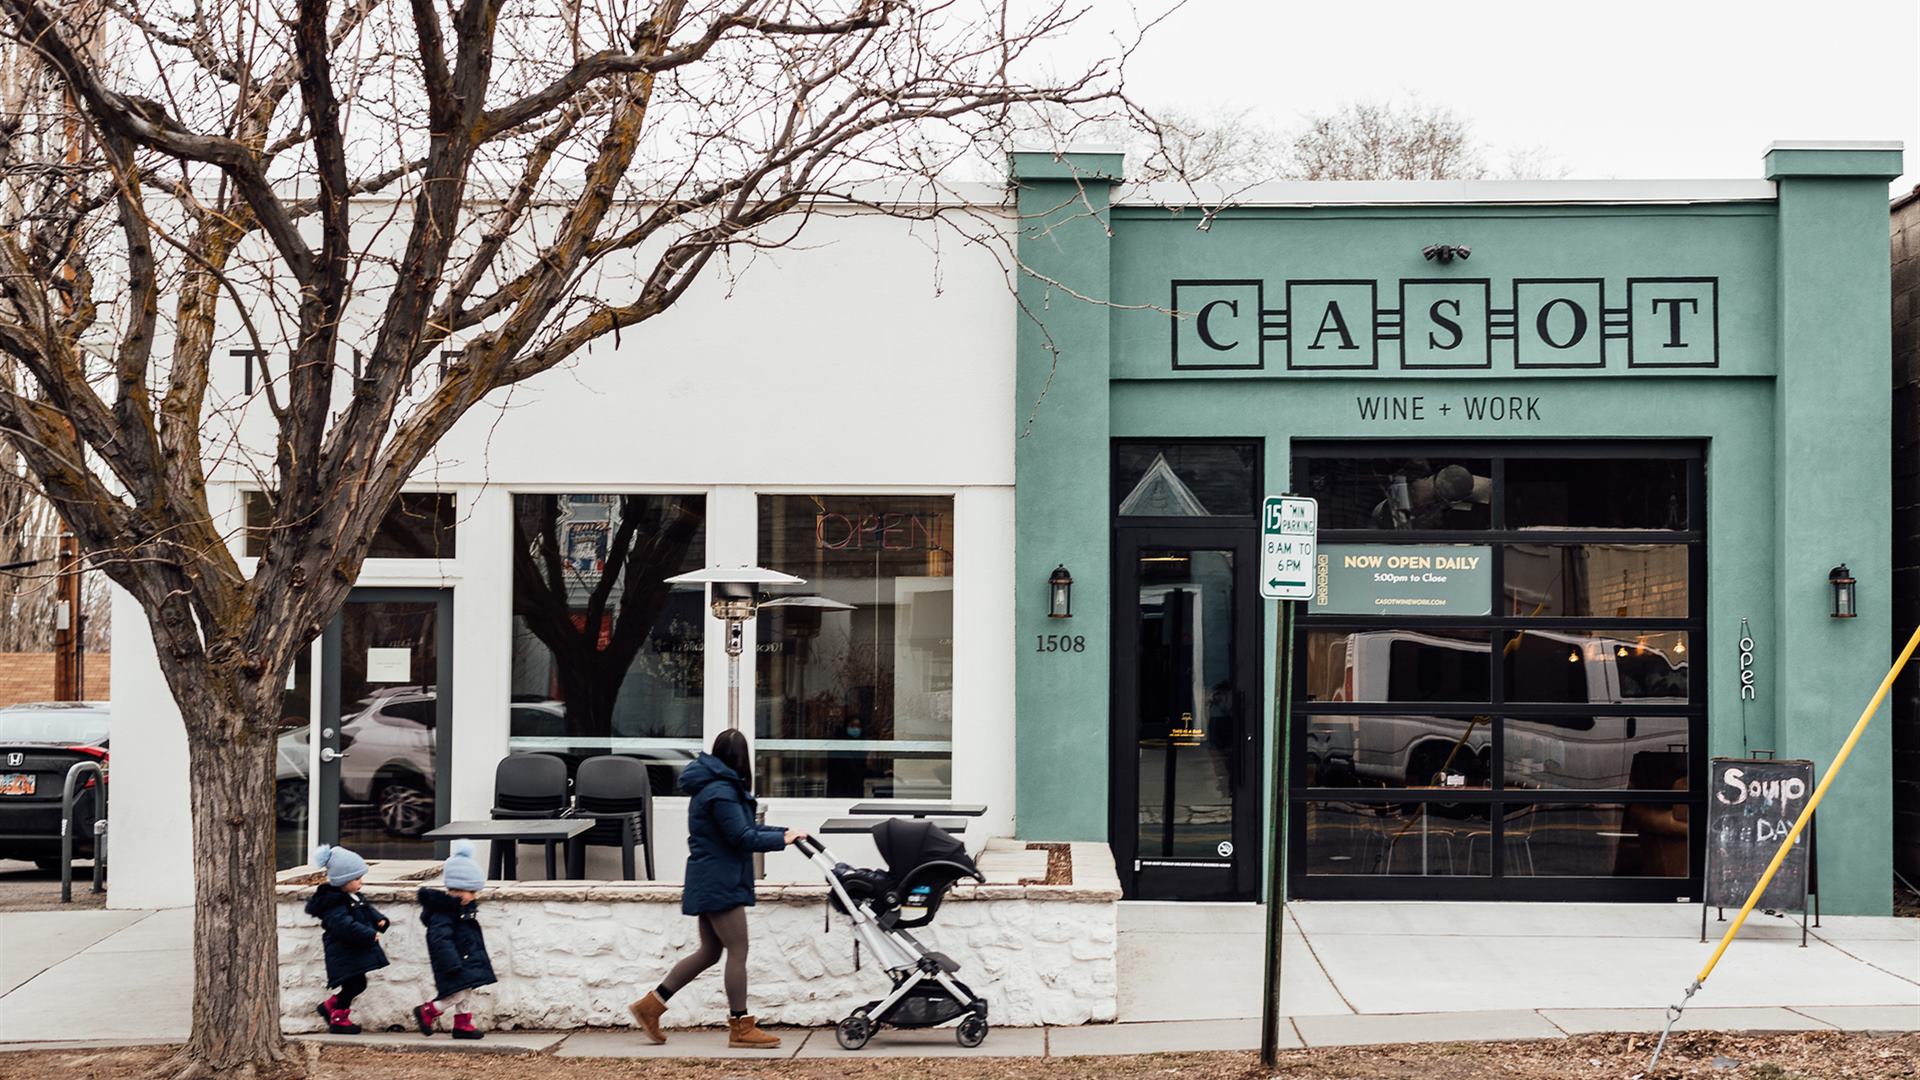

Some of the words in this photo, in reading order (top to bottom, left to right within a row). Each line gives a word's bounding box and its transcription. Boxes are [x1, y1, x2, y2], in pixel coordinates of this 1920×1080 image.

[1196, 298, 1698, 351] CASOT
[1356, 396, 1425, 421] WINE
[1463, 396, 1541, 421] WORK
[1266, 504, 1281, 529] 15
[1292, 506, 1305, 517] MIN
[1282, 519, 1313, 532] PARKING
[816, 512, 943, 550] OPEN
[1299, 542, 1312, 555] TO
[1344, 555, 1383, 568] NOW
[1387, 556, 1431, 569] OPEN
[1435, 556, 1479, 570] DAILY
[1374, 573, 1408, 583] 5:00pm
[1410, 574, 1420, 582] to
[1422, 573, 1447, 583] Close
[1036, 634, 1086, 653] 1508
[1717, 768, 1805, 816] Soup
